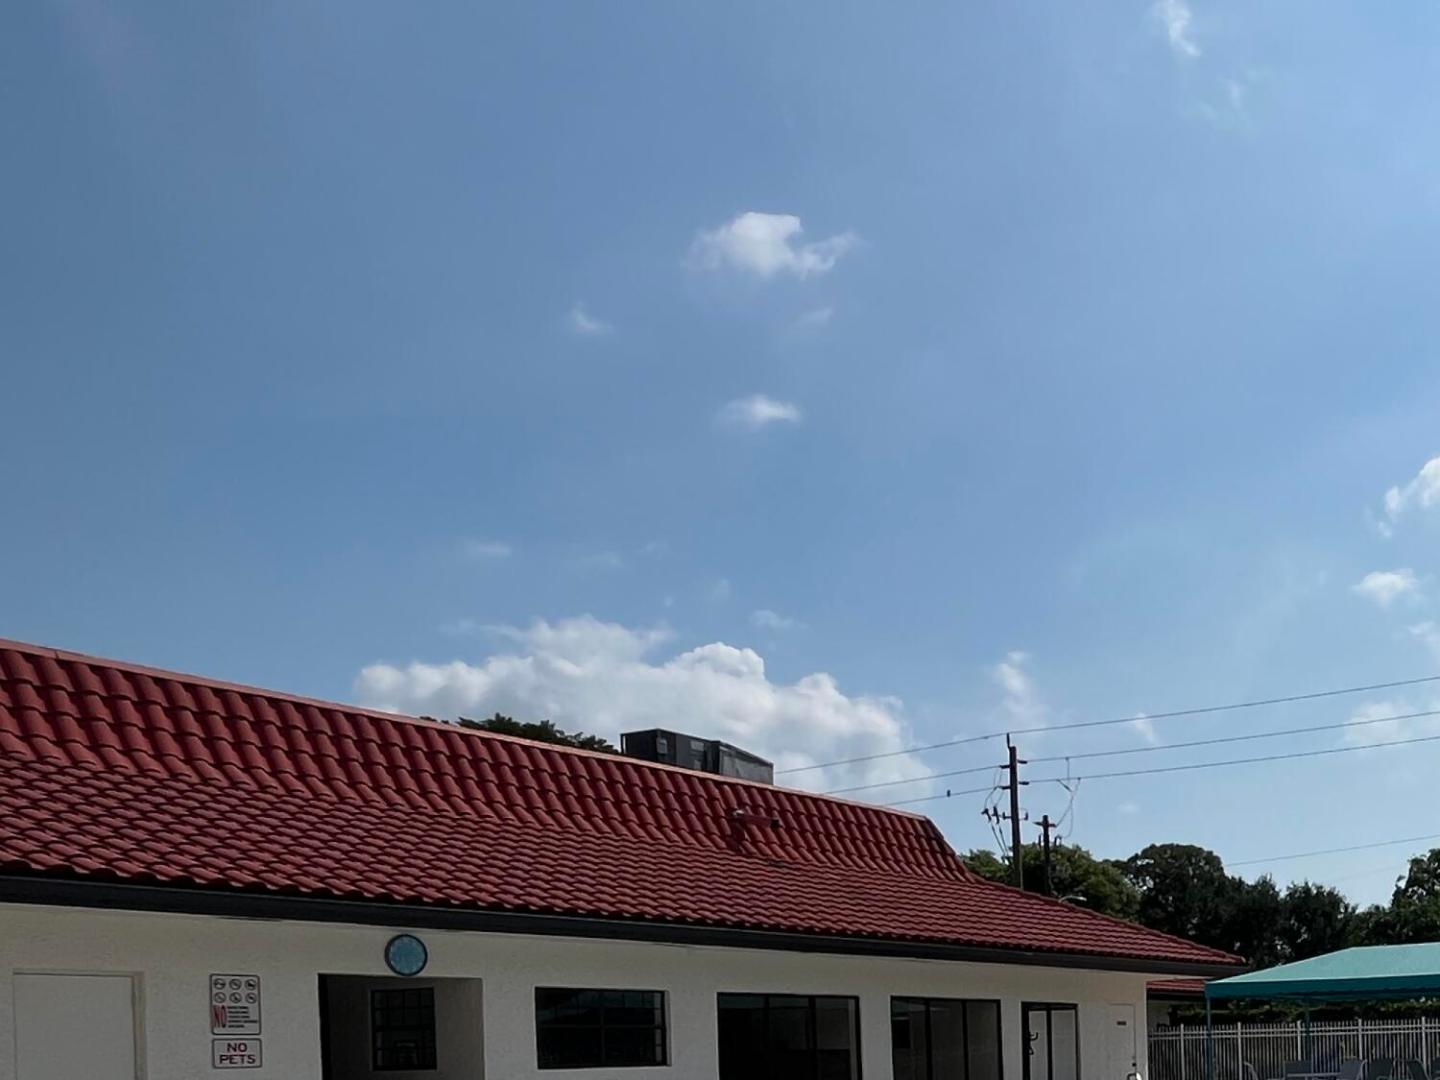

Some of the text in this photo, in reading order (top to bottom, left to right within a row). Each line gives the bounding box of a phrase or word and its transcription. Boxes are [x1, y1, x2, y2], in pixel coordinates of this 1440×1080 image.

[213, 1005, 227, 1028] NO
[227, 1042, 247, 1052] NO
[220, 1054, 256, 1064] PETS
